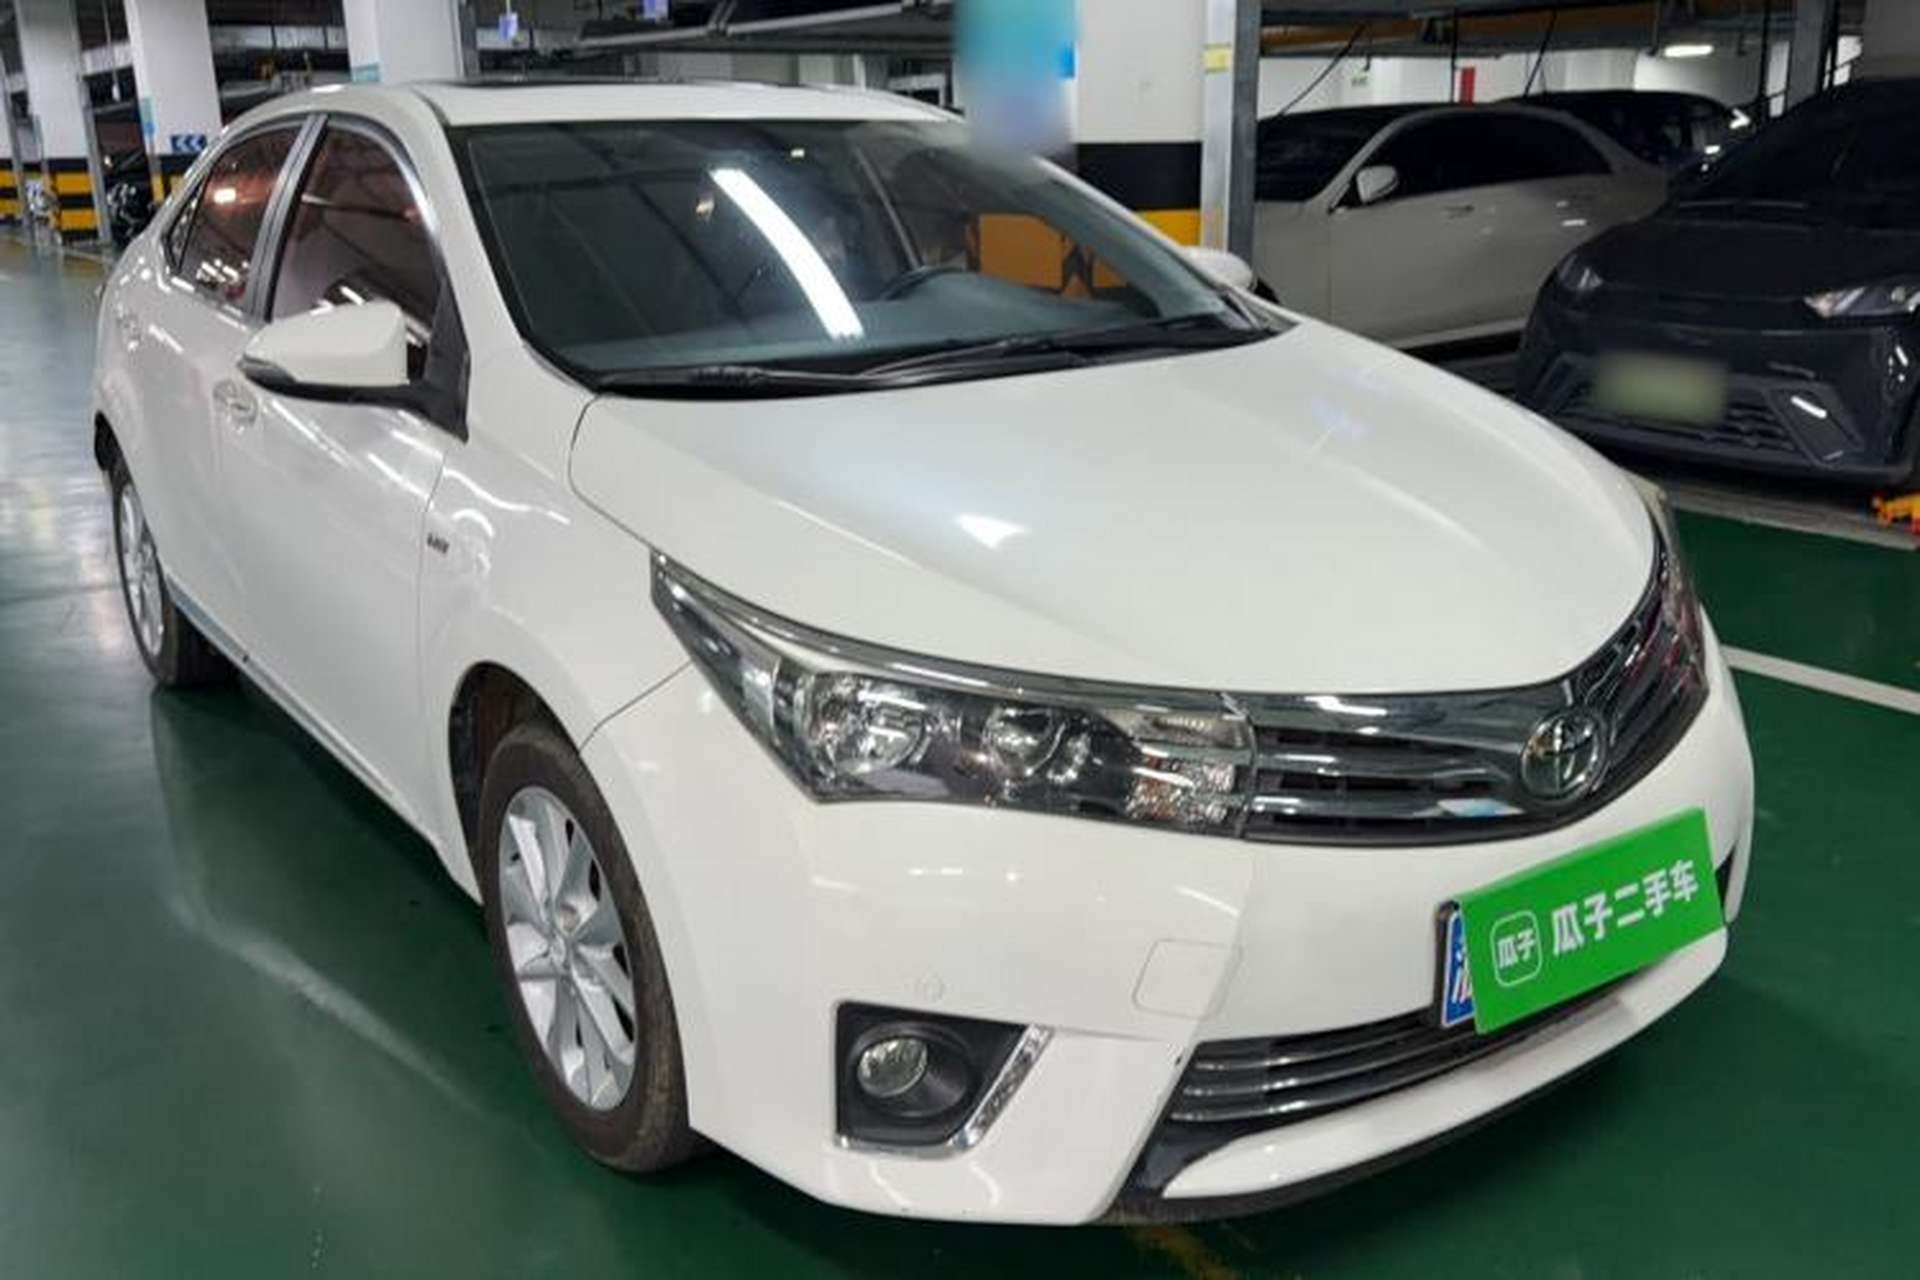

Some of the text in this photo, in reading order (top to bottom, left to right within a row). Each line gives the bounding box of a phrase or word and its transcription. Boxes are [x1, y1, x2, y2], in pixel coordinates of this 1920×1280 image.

[1552, 860, 1699, 957] 瓜子二手车
[1497, 929, 1536, 969] 瓜子
